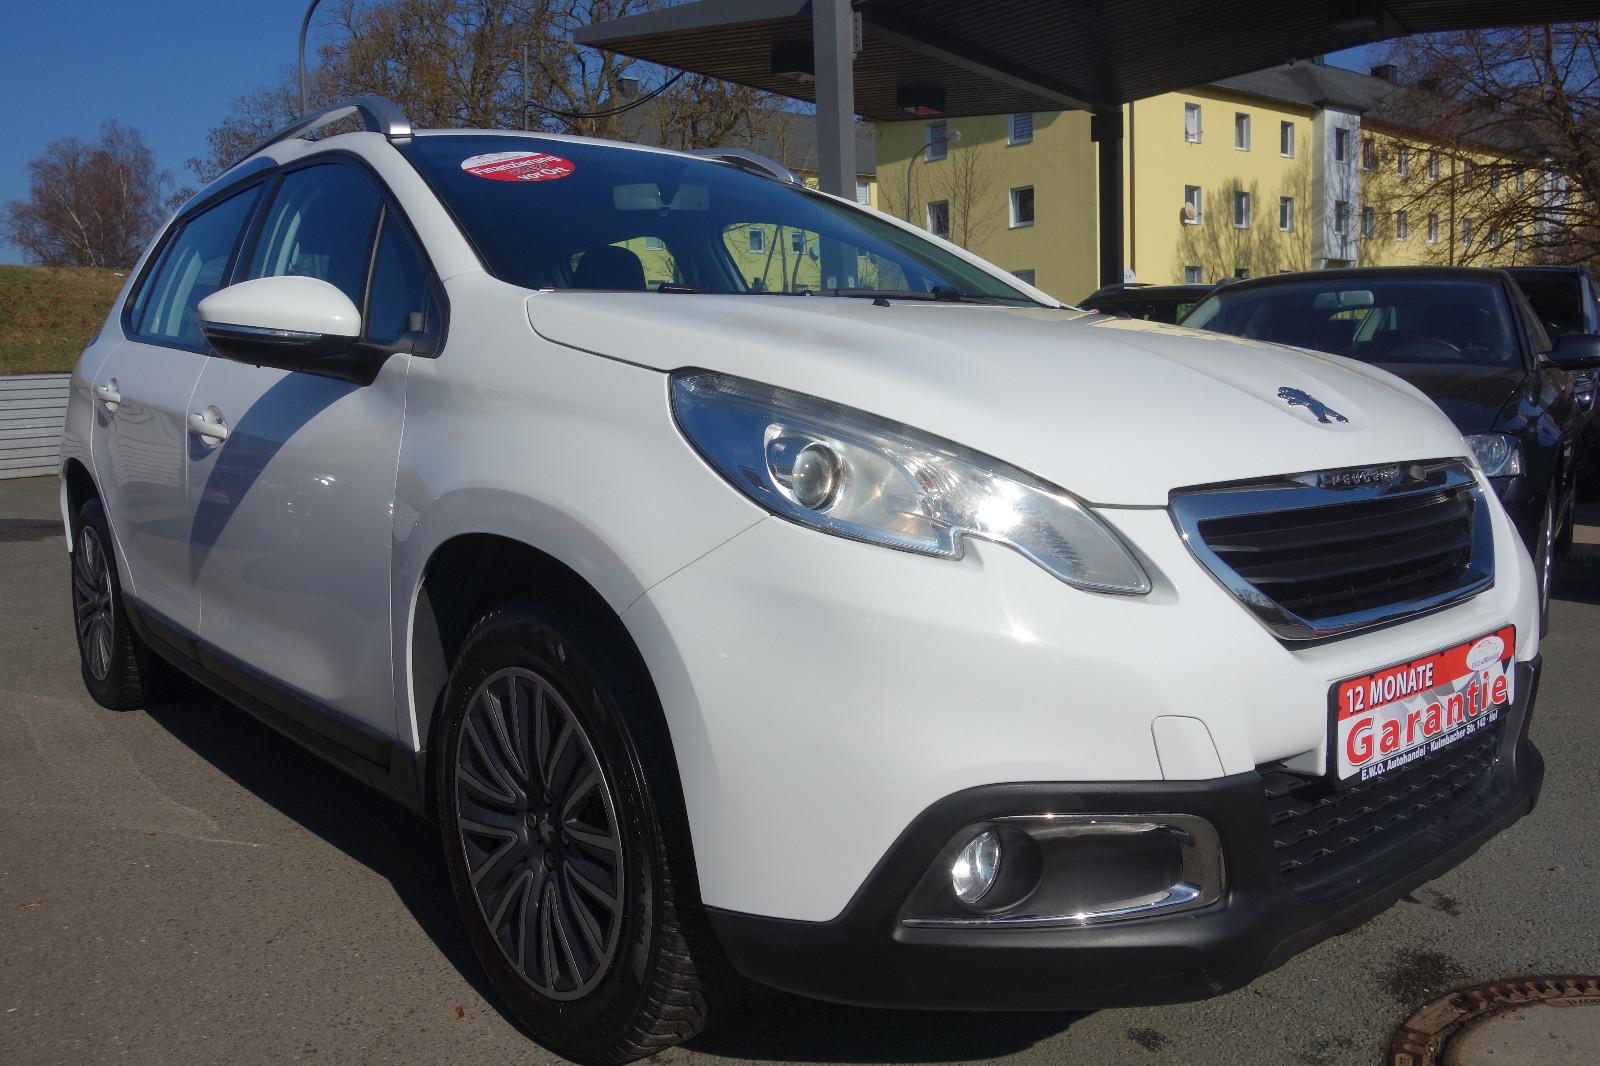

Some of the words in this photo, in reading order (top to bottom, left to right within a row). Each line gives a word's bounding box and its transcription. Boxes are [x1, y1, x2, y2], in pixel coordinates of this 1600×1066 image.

[1346, 685, 1364, 713] 12
[1369, 662, 1434, 706] MONATE
[1345, 671, 1508, 766] Garantie
[1361, 763, 1385, 781] E.W.O.
[1386, 745, 1425, 770] Autohandel
[1430, 729, 1465, 752] Kulmbacher
[1466, 723, 1476, 735] Str.
